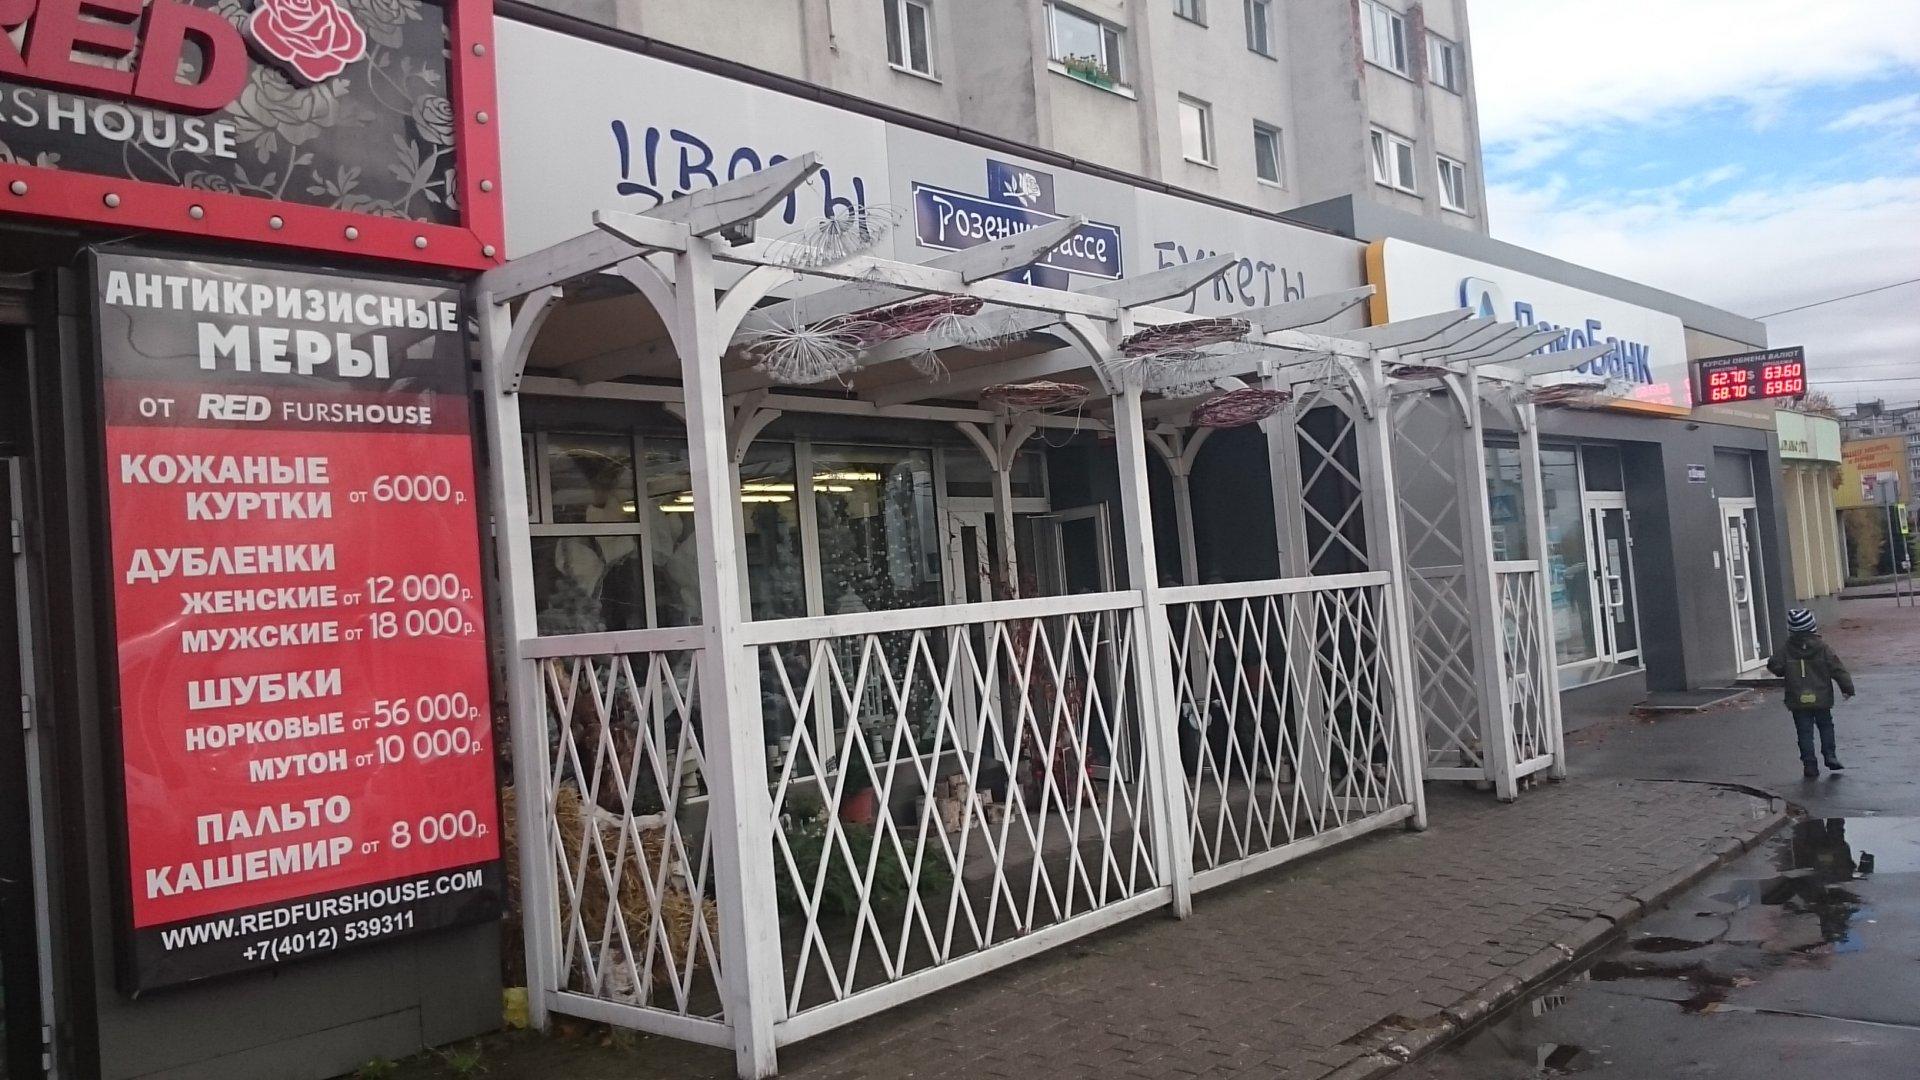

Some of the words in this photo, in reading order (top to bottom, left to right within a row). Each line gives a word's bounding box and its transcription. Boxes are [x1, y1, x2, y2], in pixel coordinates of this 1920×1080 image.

[0, 87, 238, 159] SHOUSE
[106, 270, 458, 331] АНТИКРИЗИСНЫЕ
[198, 323, 390, 379] МЕРЫ
[1710, 370, 1746, 386] 62.70
[1764, 364, 1801, 380] 63.60
[1712, 385, 1747, 401] 68.70
[1766, 379, 1802, 395] 69.60
[198, 394, 271, 421] RED
[283, 403, 432, 425] FURSHOUSE
[121, 455, 329, 485] КОЖАНЫЕ
[373, 476, 451, 502] 6000
[187, 492, 332, 521] КУРТКИ
[126, 544, 335, 584] ДУБЛЕНКИ
[181, 587, 337, 615] ЖЕНСКИЕ
[182, 622, 338, 654] МУЖСКИЕ
[188, 669, 342, 710] ШУБКИ
[186, 712, 344, 751] НОРКОВЫЕ
[249, 750, 348, 783] МУТОН
[197, 796, 350, 845] ПАЛЬТО
[146, 836, 352, 899] КАШЕМИР
[161, 869, 482, 950] WWW.REDFURSHOUSE.COM
[243, 928, 338, 961] +7(4012)
[345, 911, 415, 942] 539311
